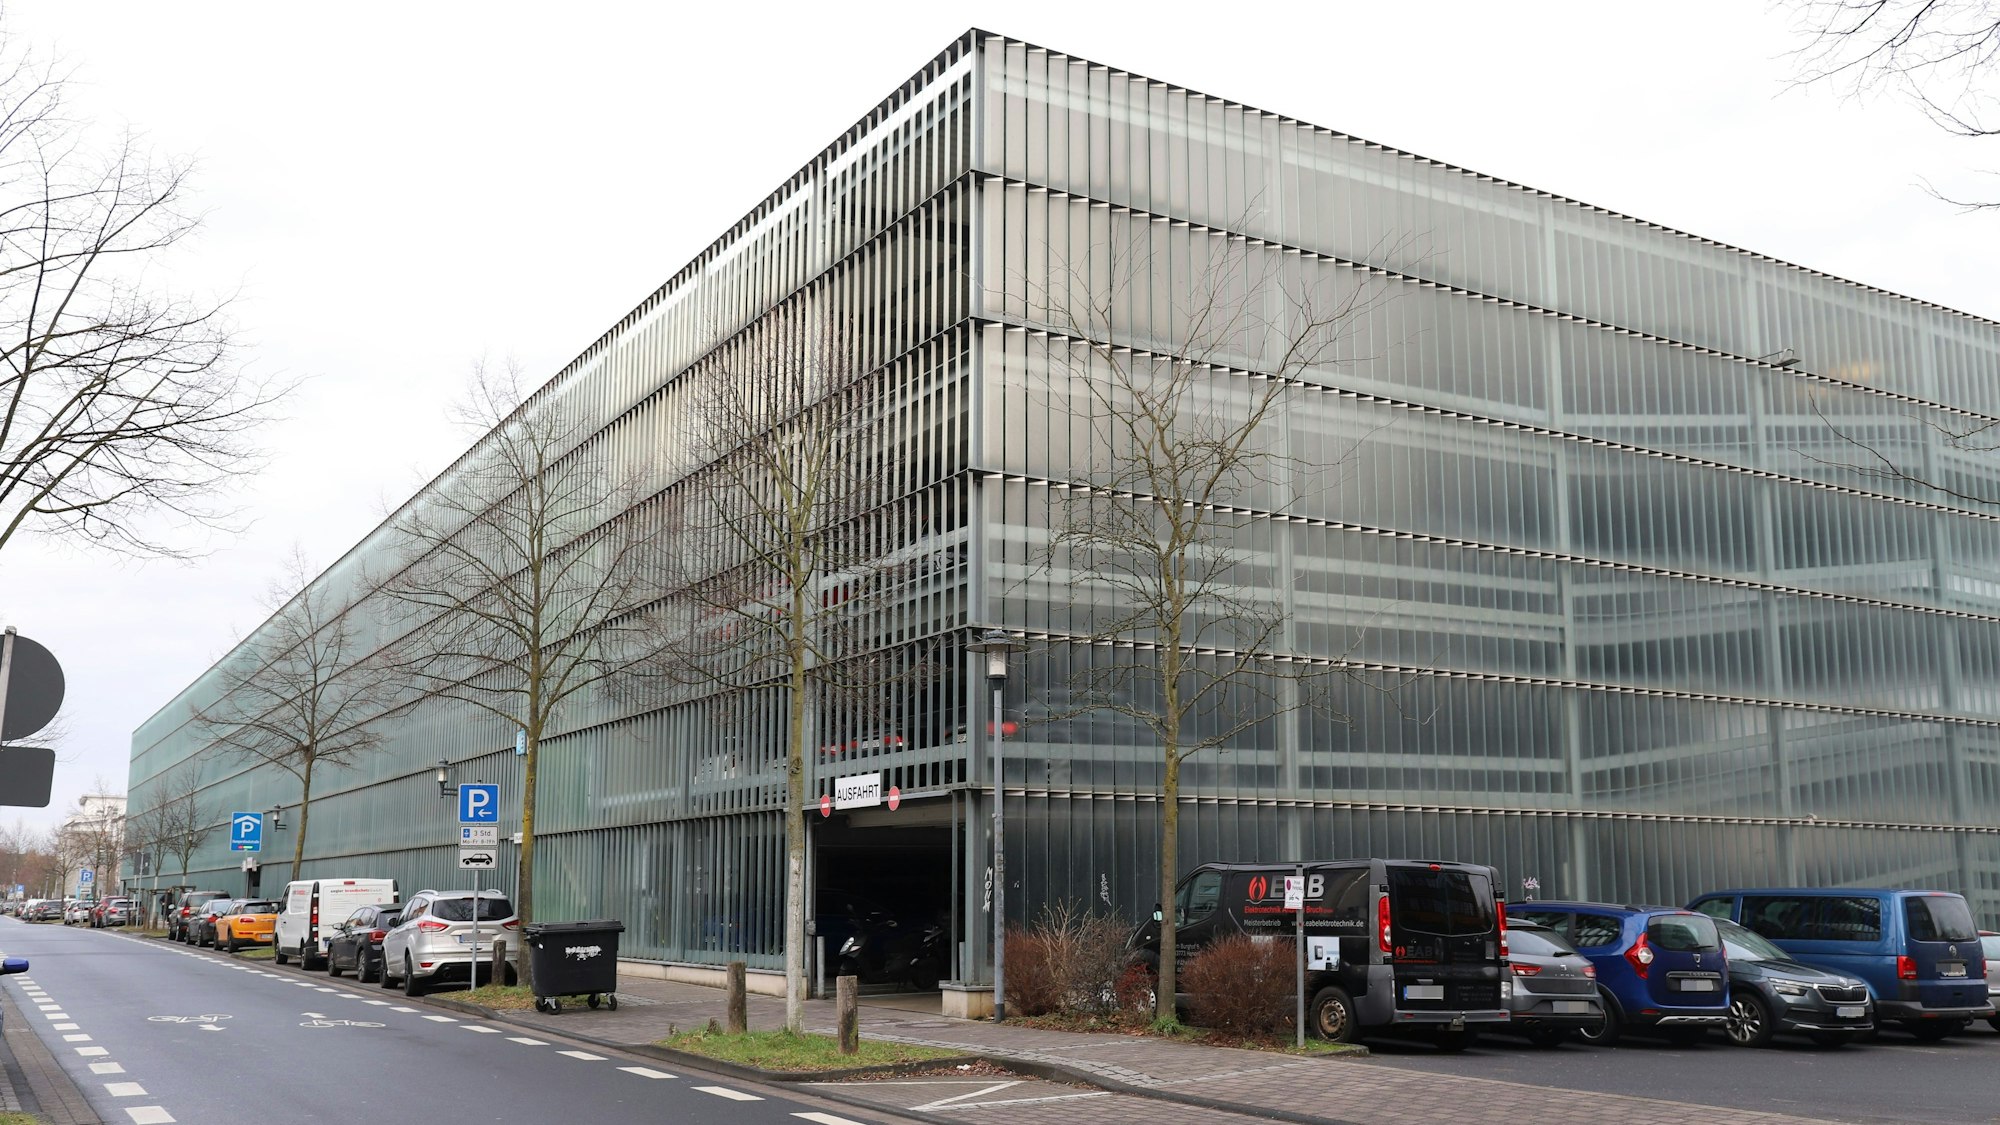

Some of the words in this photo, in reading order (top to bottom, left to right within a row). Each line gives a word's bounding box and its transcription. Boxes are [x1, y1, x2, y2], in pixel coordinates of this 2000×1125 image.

[837, 784, 879, 802] AUSFAHRT
[468, 789, 490, 818] P
[241, 821, 254, 838] P
[1270, 873, 1325, 898] EB
[1244, 905, 1281, 914] Elektrotechnik
[1306, 905, 1324, 914] Bruch
[1243, 919, 1281, 927] Meisterbetrieb
[1291, 919, 1364, 928] w.eabelektrotechnik.de
[1406, 946, 1433, 956] EAB
